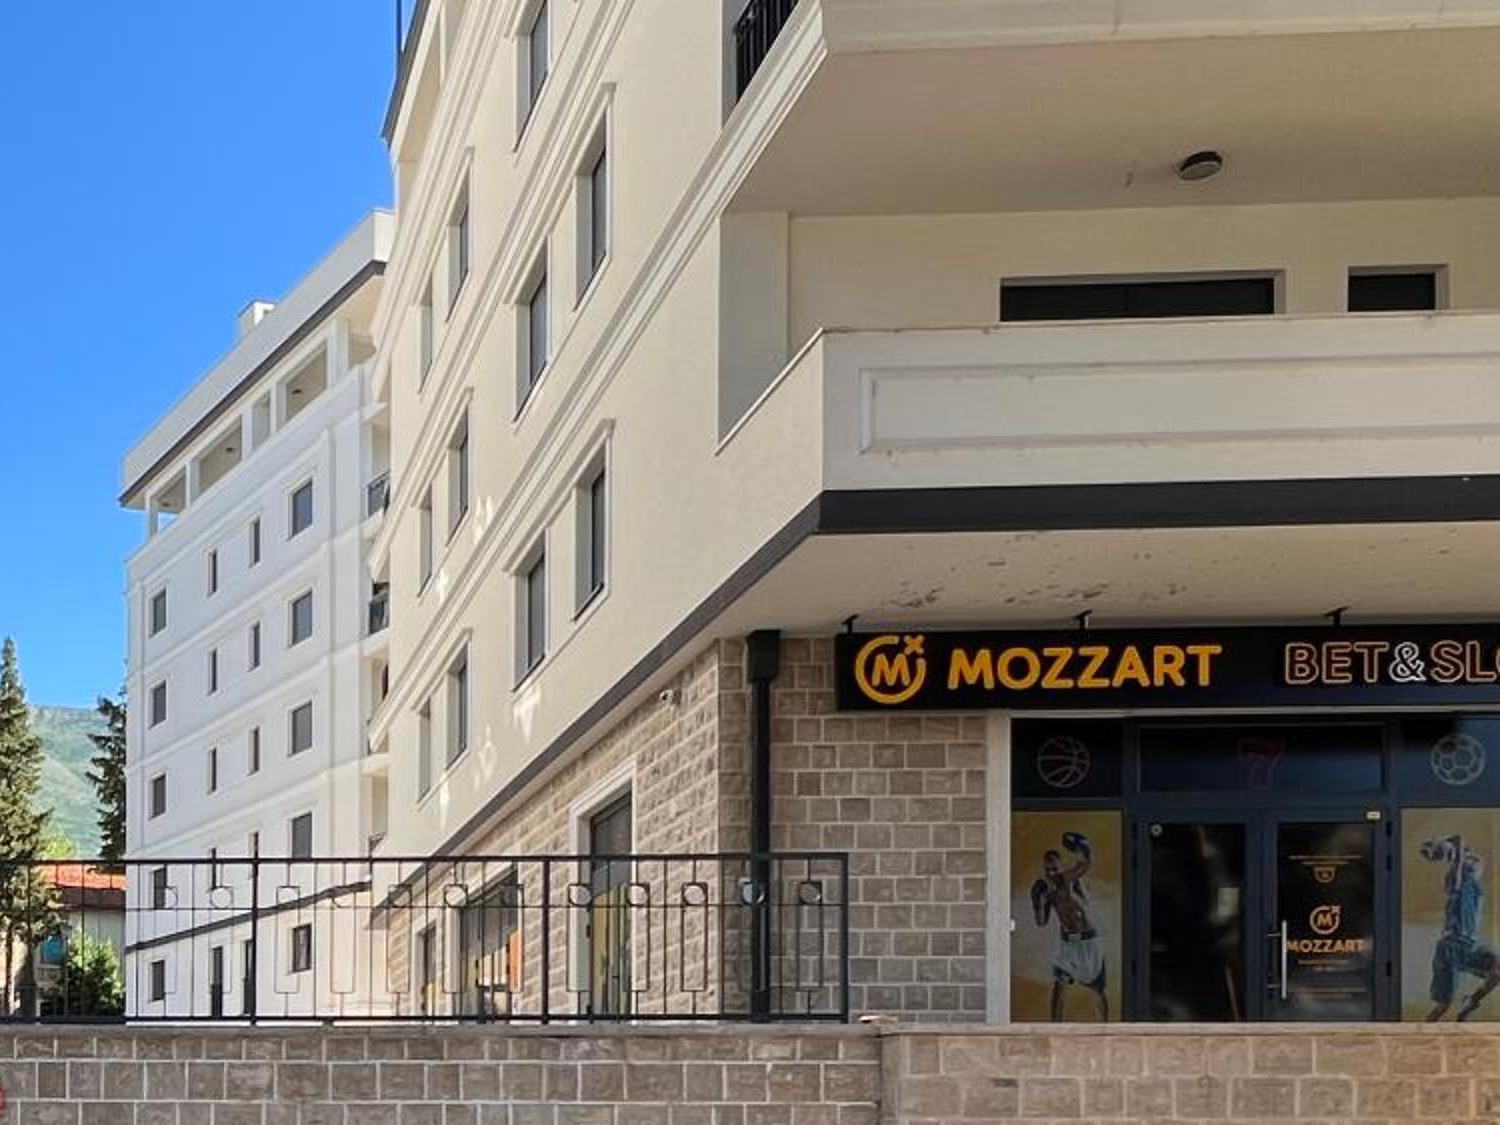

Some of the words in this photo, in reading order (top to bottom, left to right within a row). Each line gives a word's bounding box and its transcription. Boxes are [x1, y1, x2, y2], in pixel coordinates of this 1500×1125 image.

[947, 645, 1222, 690] MOZZART
[1285, 640, 1500, 684] BET&SL
[1285, 939, 1365, 953] MOZZART
